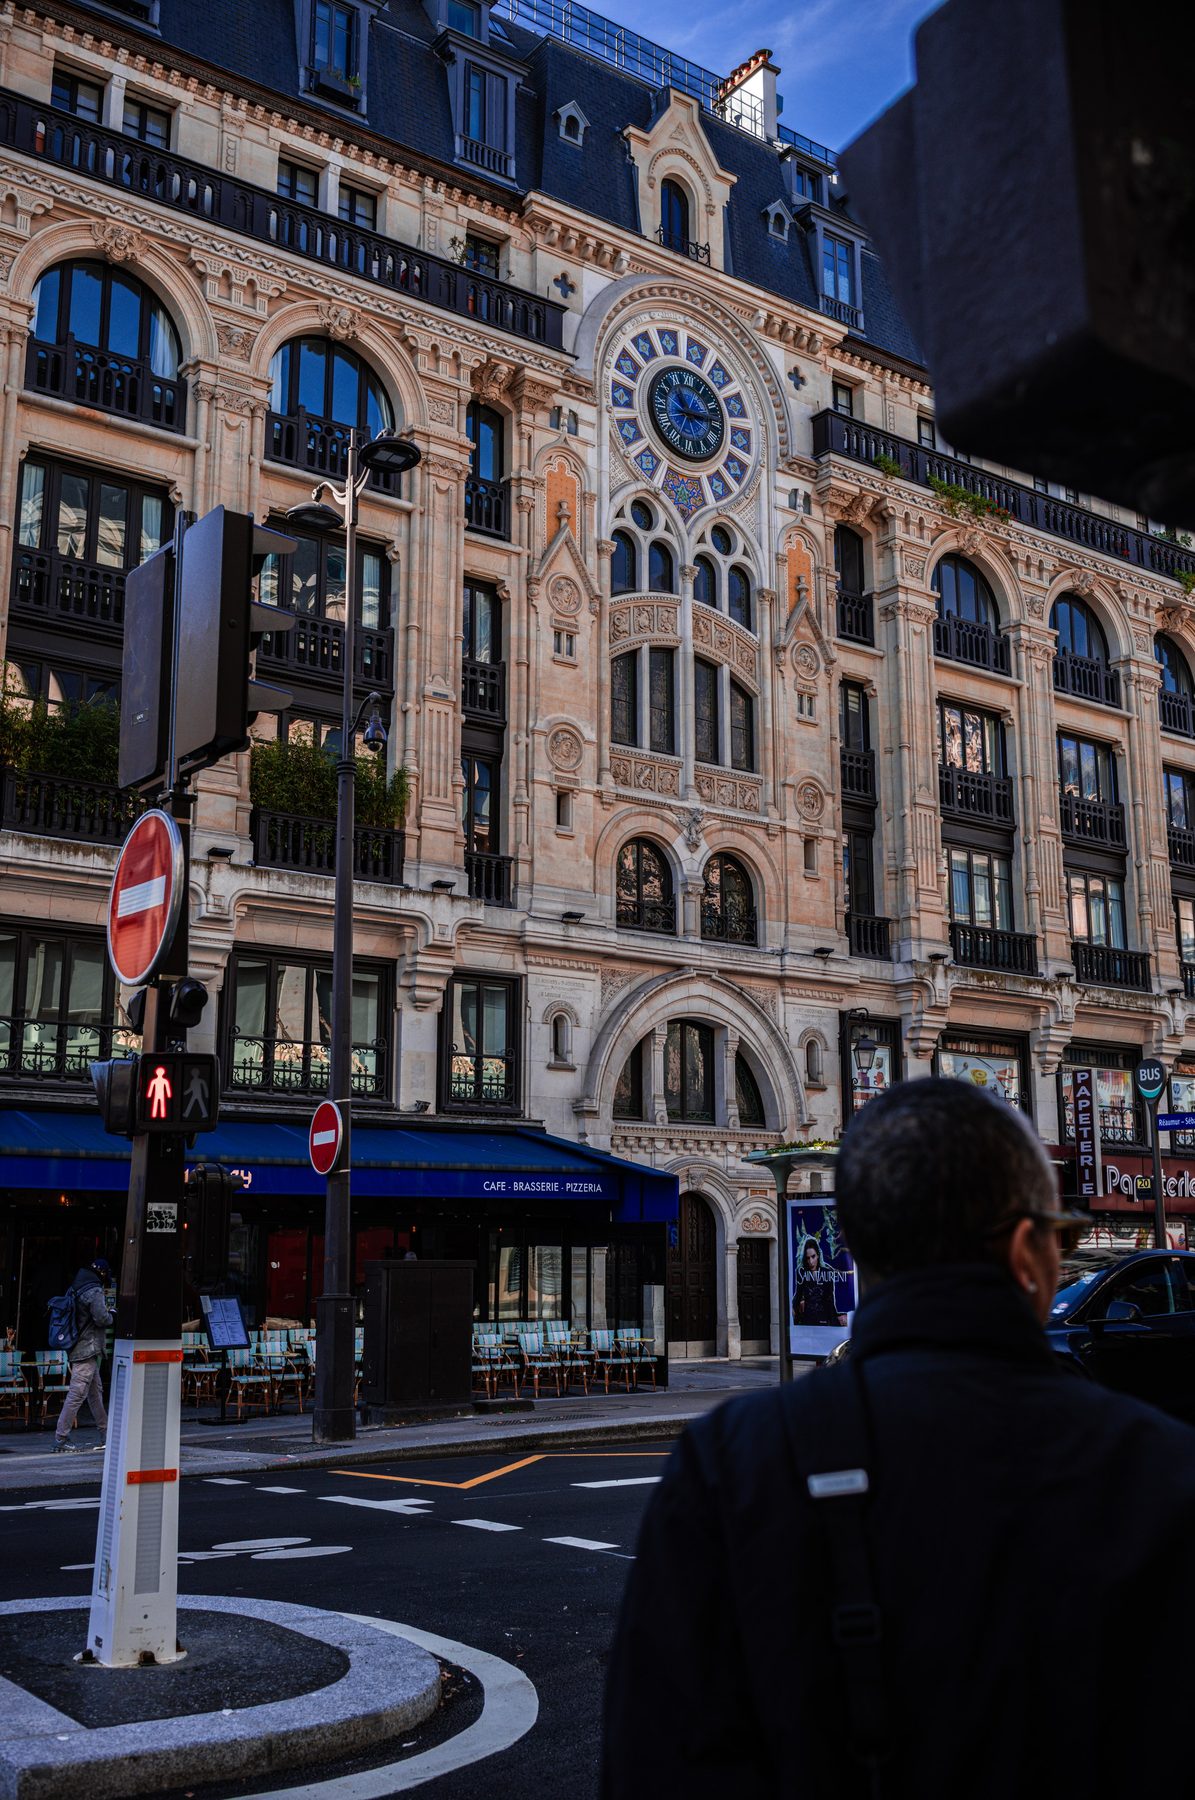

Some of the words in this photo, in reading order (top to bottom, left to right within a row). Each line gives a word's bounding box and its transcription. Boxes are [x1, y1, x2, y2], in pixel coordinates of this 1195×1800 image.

[683, 374, 694, 388] XII
[1139, 1068, 1161, 1082] BUS
[1158, 1118, 1181, 1127] Réaumur
[1075, 1072, 1095, 1195] PAPETERIE
[483, 1181, 506, 1191] CAFE
[513, 1182, 559, 1192] BRASSERIE
[566, 1183, 602, 1193] PIZZERIA
[1139, 1179, 1149, 1188] 20
